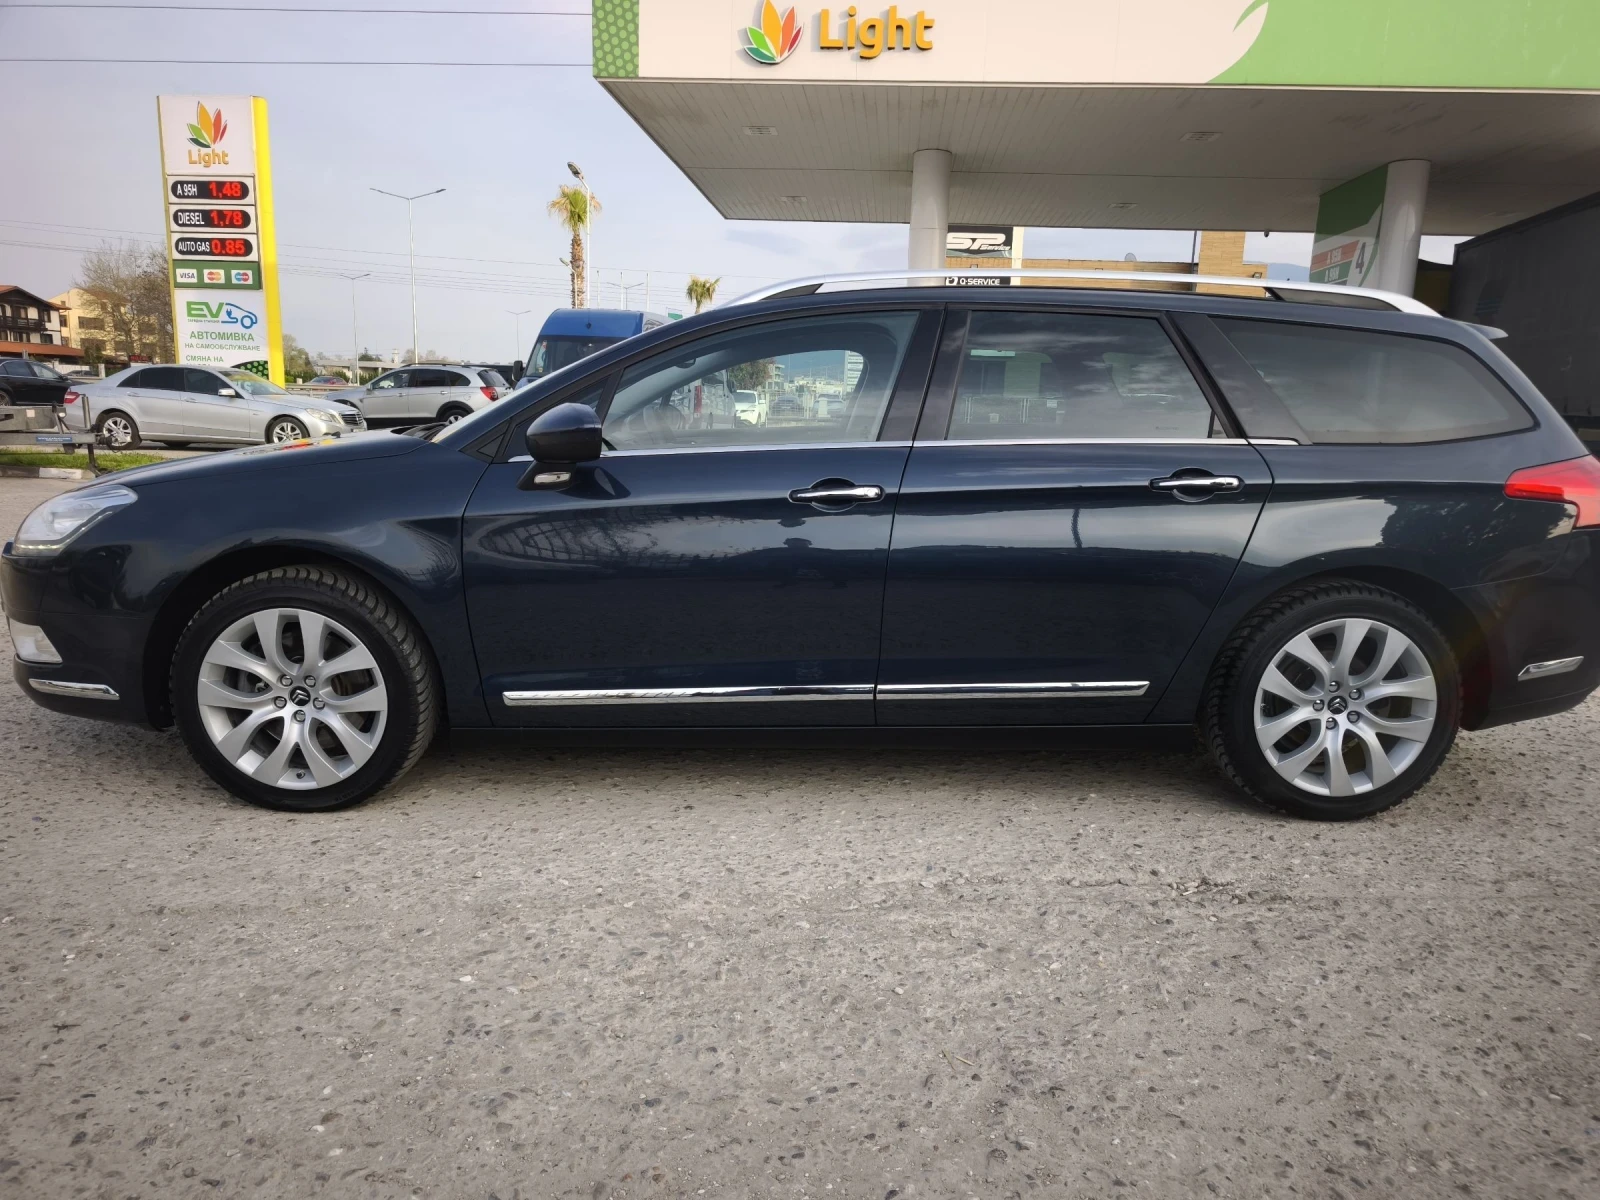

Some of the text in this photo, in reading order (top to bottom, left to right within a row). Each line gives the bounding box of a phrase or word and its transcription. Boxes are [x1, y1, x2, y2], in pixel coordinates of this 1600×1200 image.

[819, 5, 935, 59] Light
[188, 148, 229, 168] Light
[177, 184, 182, 196] A
[184, 184, 197, 196] 95H
[178, 212, 205, 224] DIESEL
[178, 240, 245, 254] AUTO GAS 0.85
[1356, 242, 1366, 274] 4
[186, 301, 224, 318] EV
[189, 331, 255, 341] АВТОМИВКА
[195, 343, 261, 351] САМООБСЛУЖВАНЕ
[185, 354, 211, 362] СМЯНА
